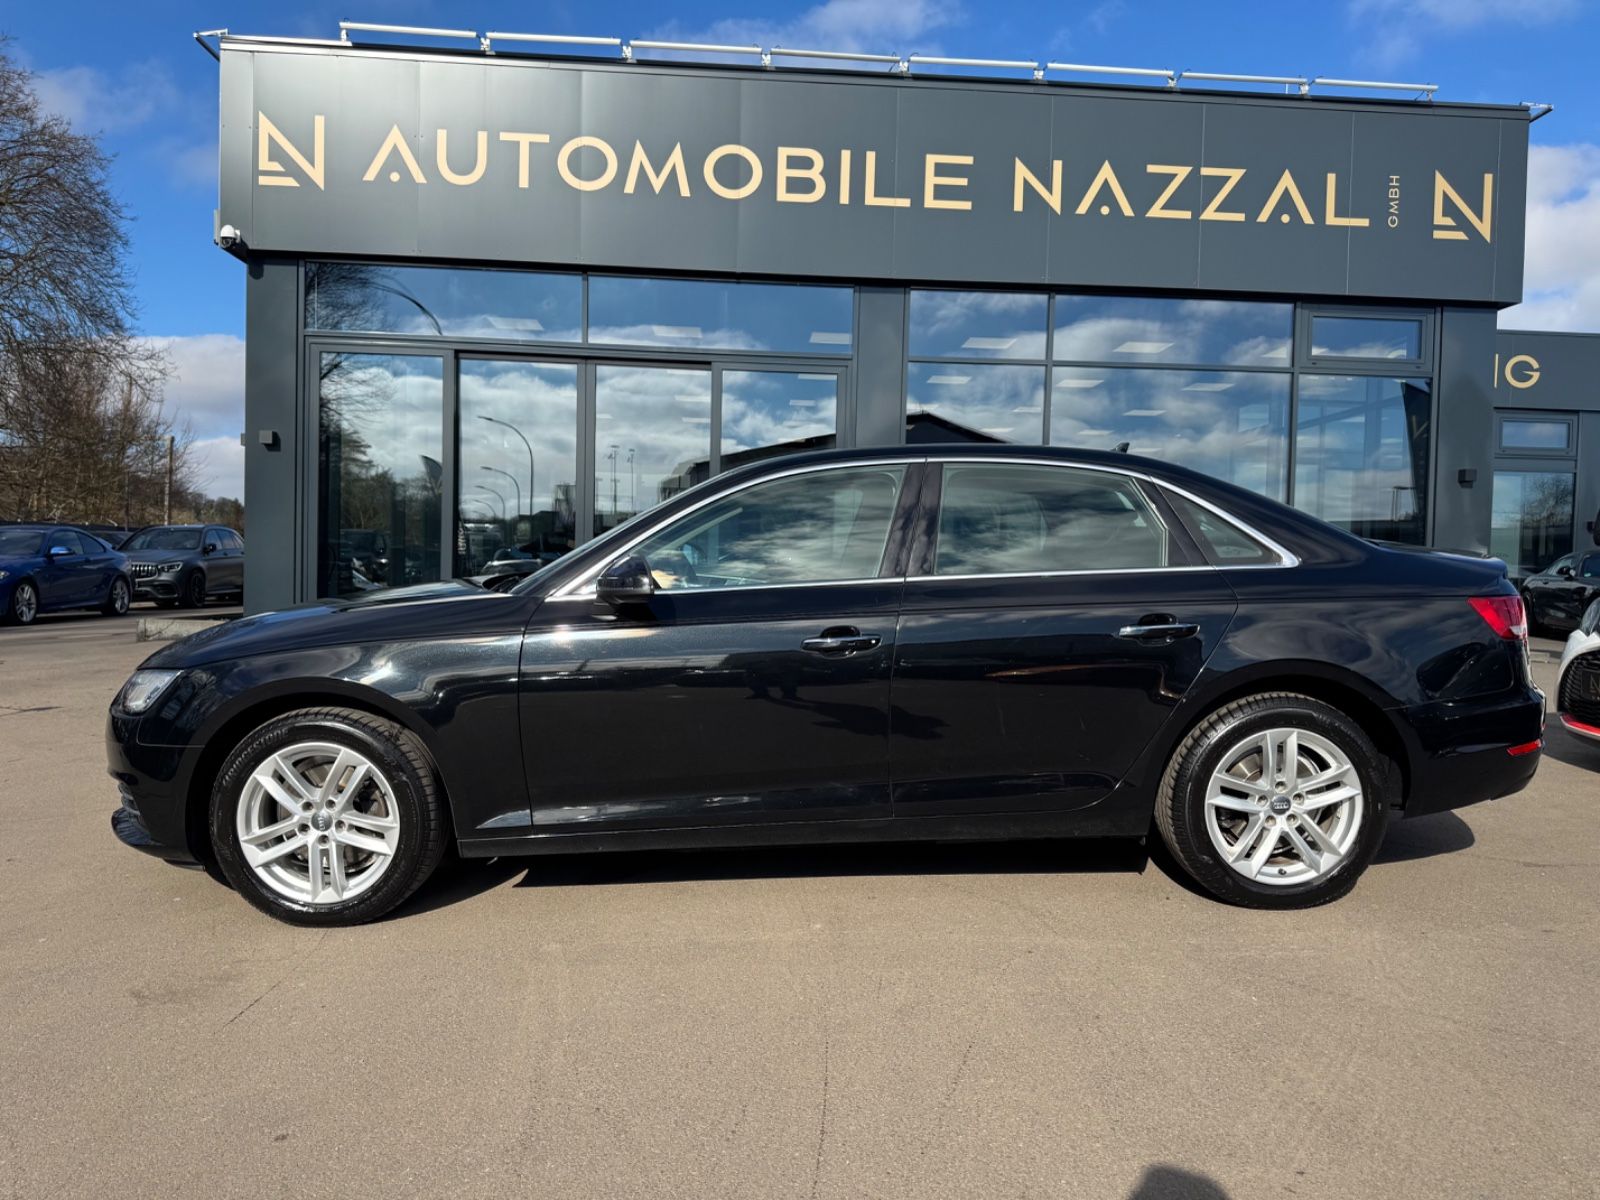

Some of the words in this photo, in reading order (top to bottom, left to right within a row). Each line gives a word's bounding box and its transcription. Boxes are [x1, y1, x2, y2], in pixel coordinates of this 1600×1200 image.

[362, 124, 974, 211] AUTOMOBILE
[1013, 157, 1370, 227] NAZZAL
[1387, 175, 1400, 228] GMBH
